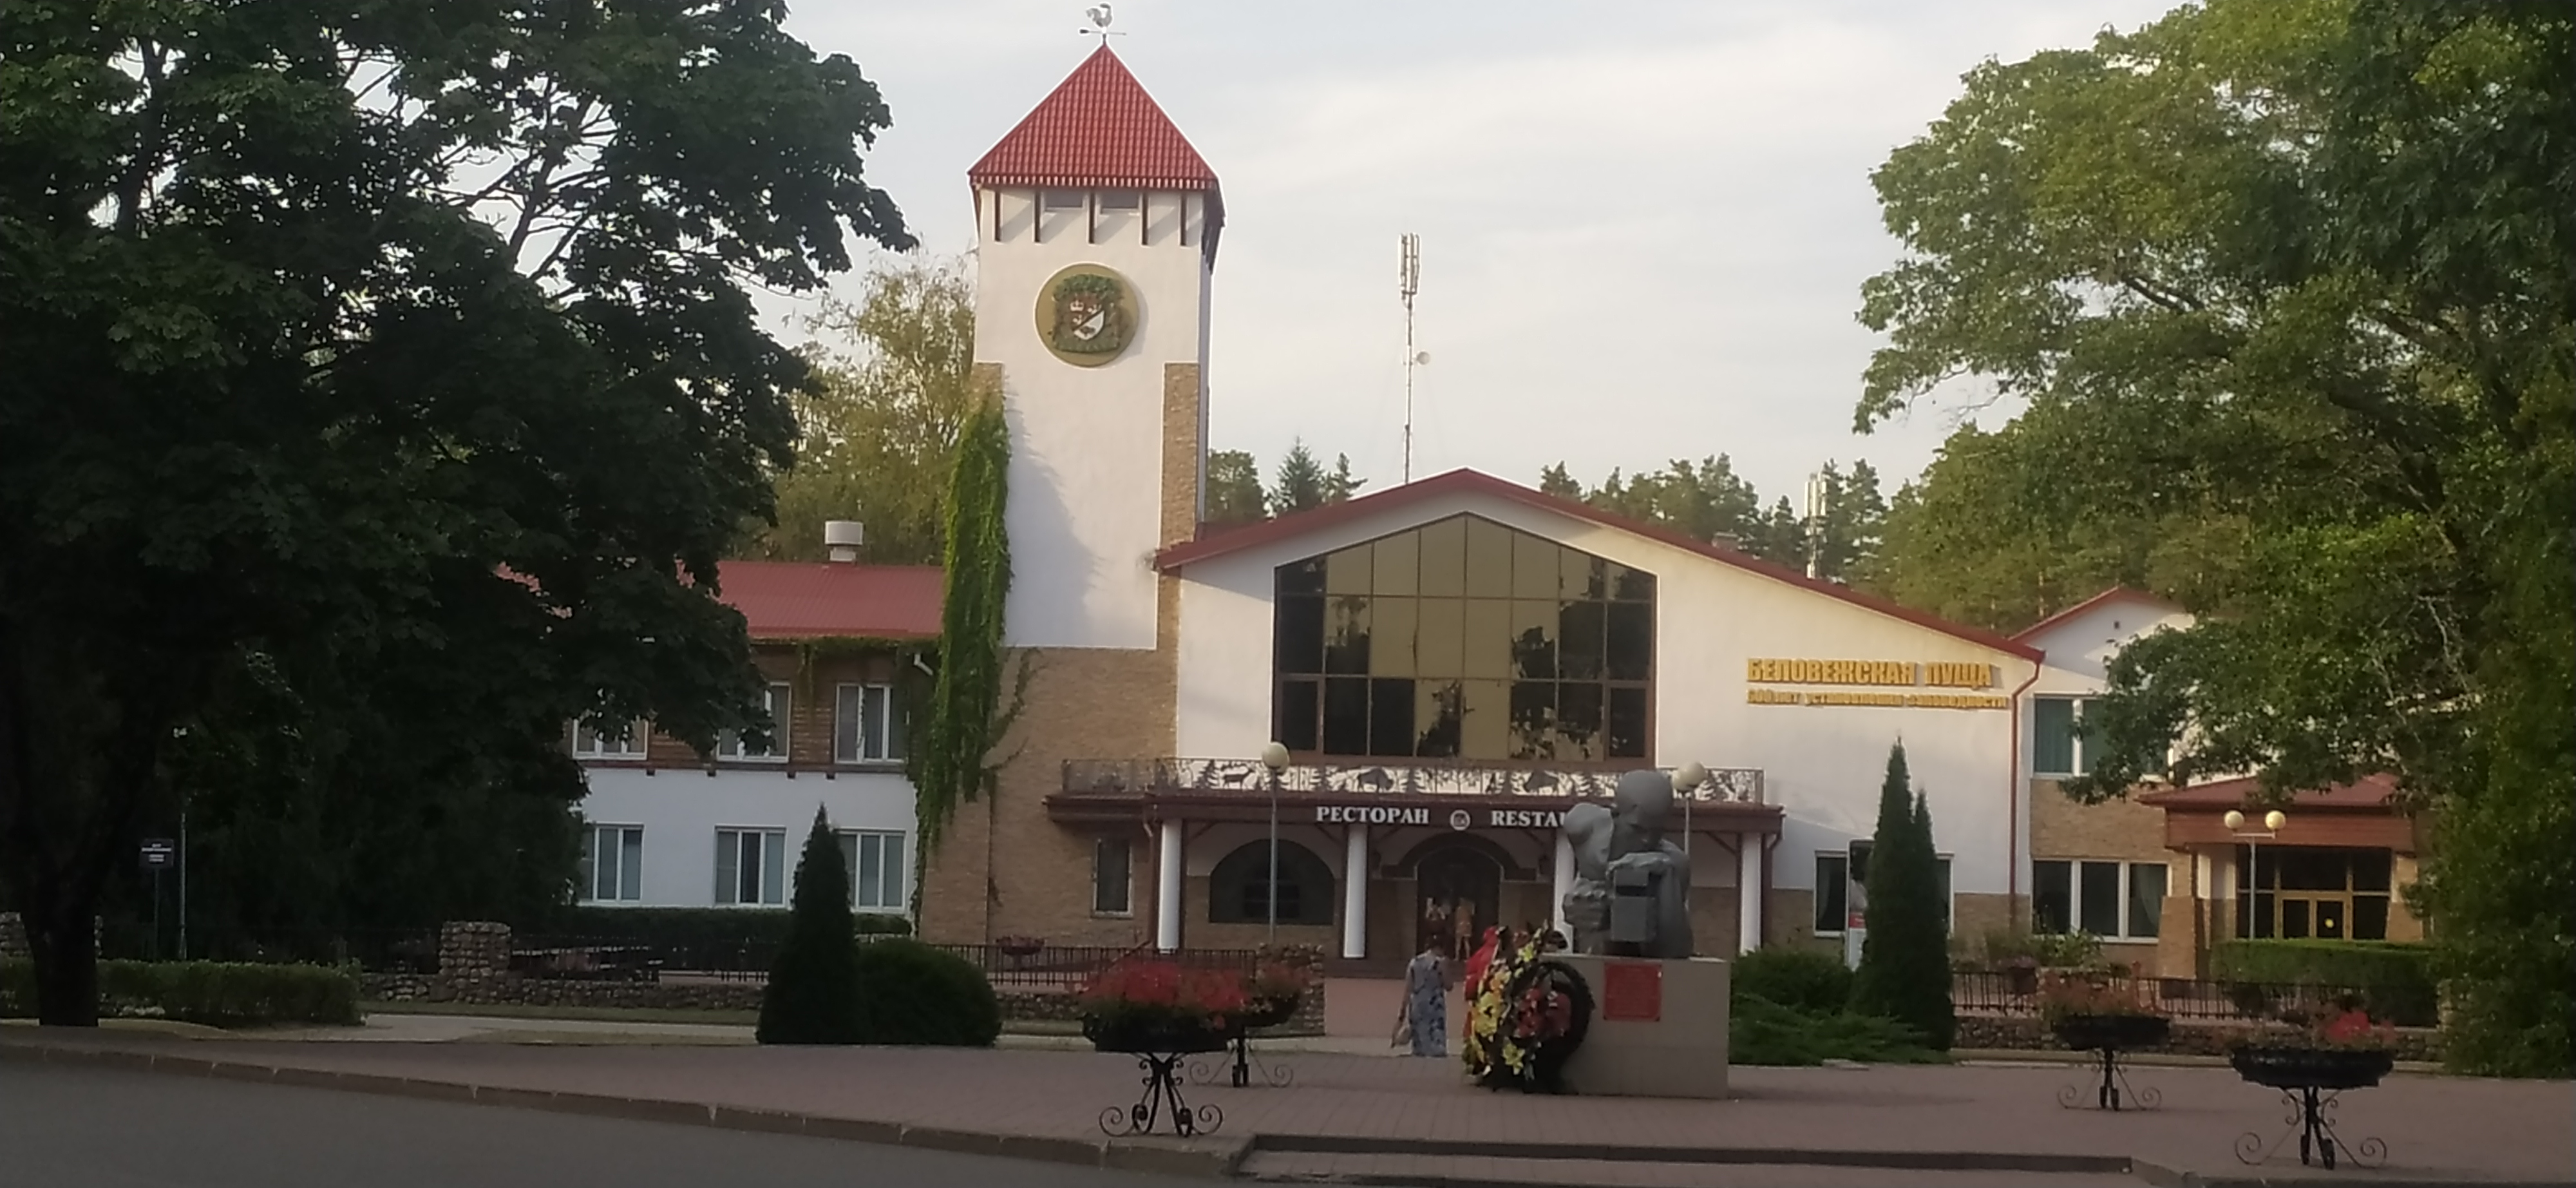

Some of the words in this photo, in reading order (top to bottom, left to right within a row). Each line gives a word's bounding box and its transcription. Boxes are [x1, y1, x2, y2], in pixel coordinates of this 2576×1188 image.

[1747, 658, 1916, 687] БЕЛОВЕЖСКАЯ
[1924, 662, 1993, 689] ПУЩА
[1316, 805, 1430, 825] РЕСТОРАН
